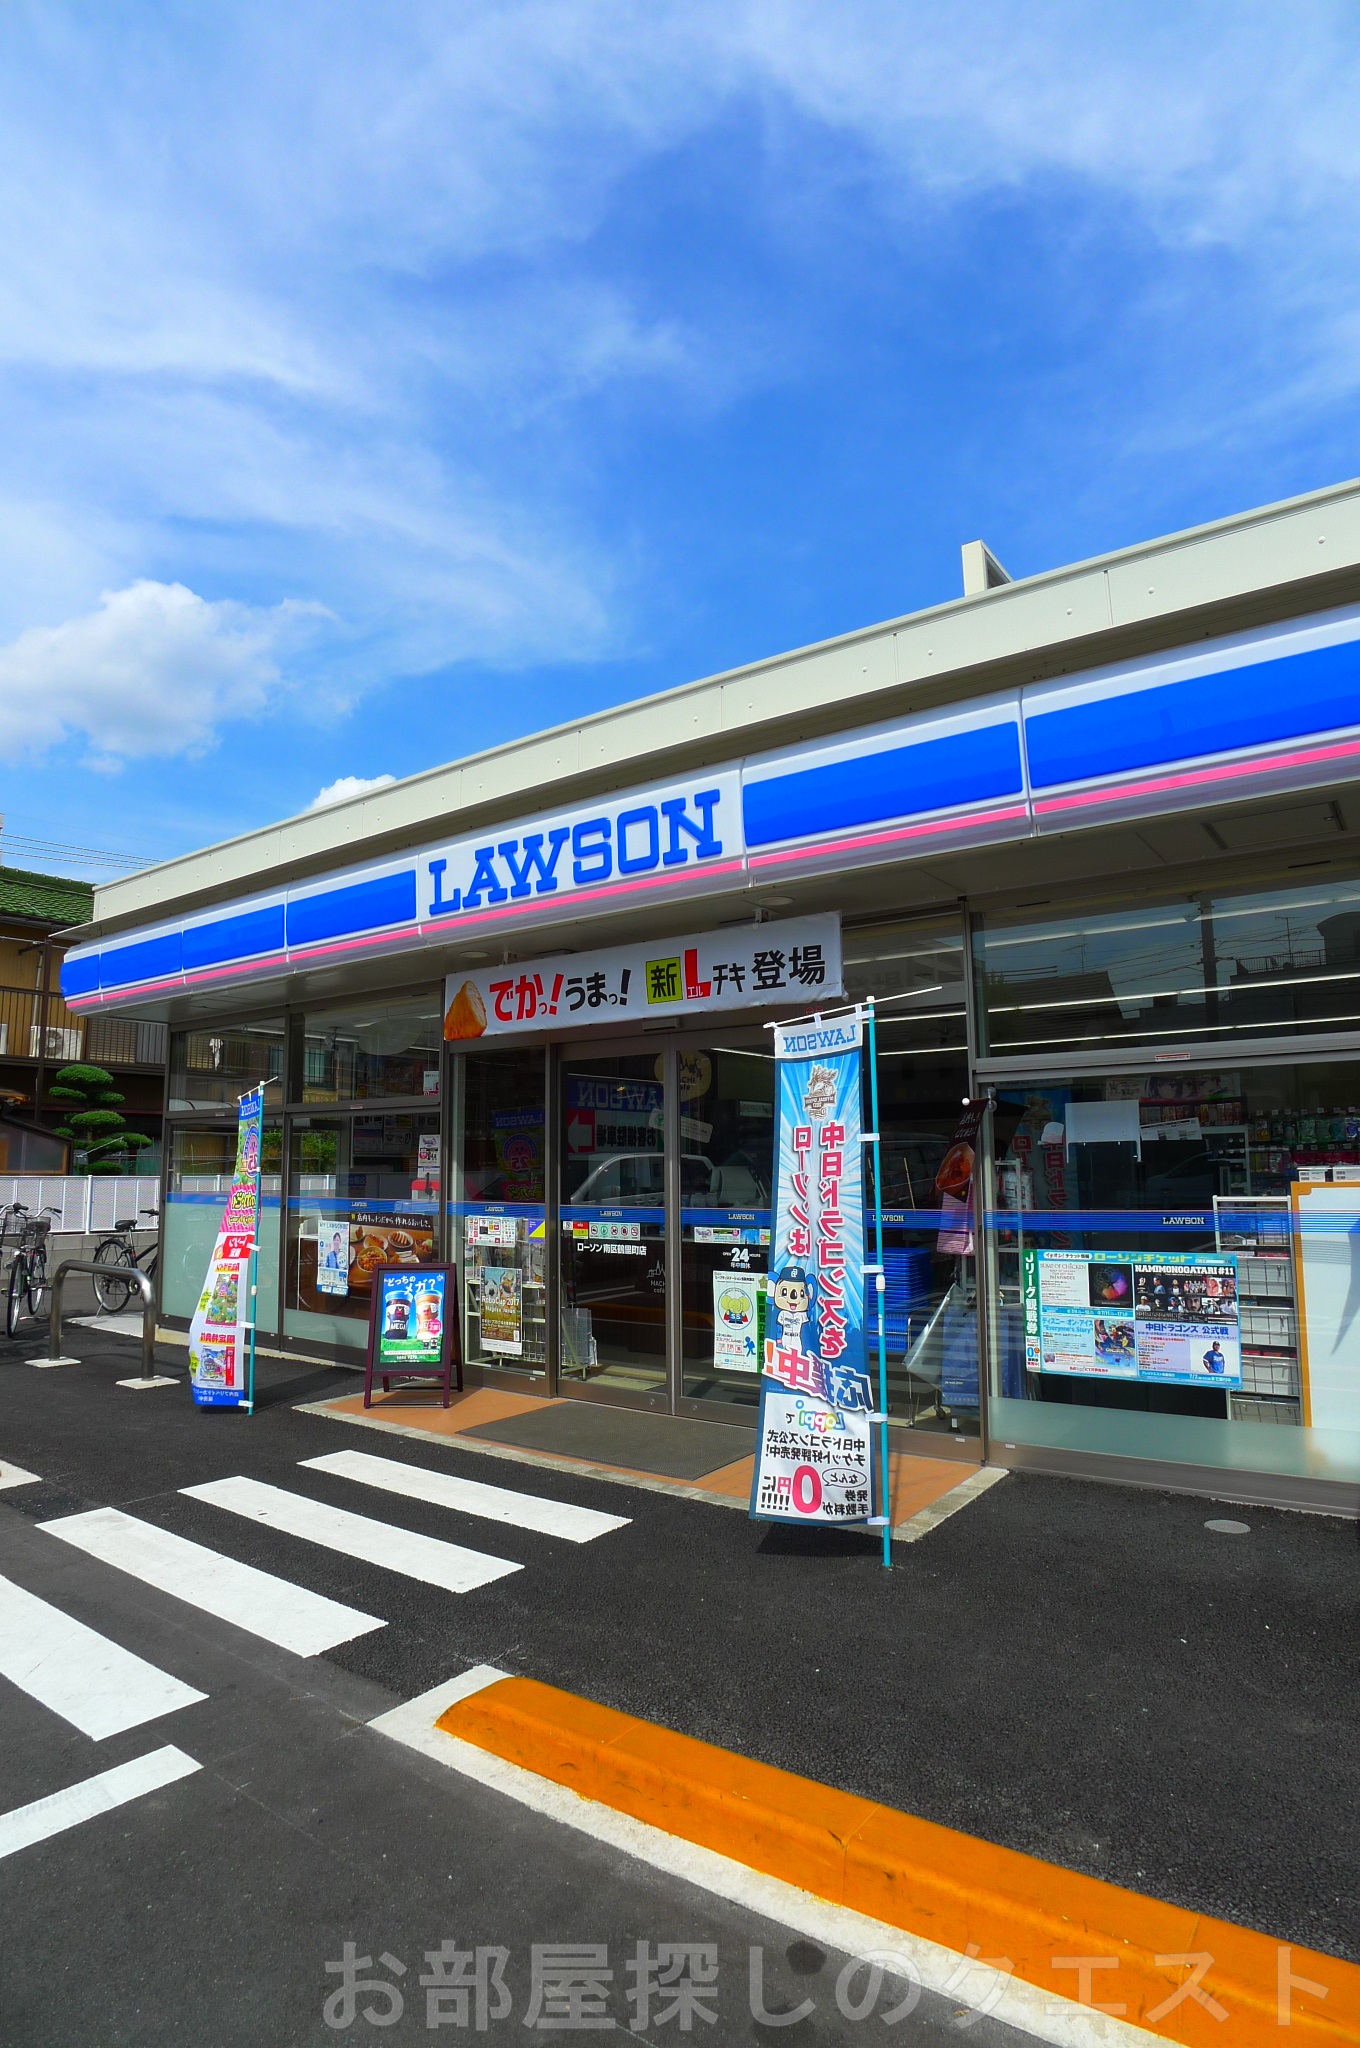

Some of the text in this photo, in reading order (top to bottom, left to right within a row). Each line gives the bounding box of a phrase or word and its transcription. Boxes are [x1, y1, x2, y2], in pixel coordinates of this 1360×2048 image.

[428, 788, 723, 916] LAWSON
[871, 1214, 904, 1222] LWSON
[1162, 1217, 1205, 1225] LAWSON
[577, 1242, 647, 1256] ローソン南区鶴里町店
[731, 1247, 750, 1262] 24
[1094, 1252, 1192, 1263] ローソンチケット
[1135, 1265, 1217, 1274] NAMIMONOGATARI
[387, 1276, 416, 1287] どっちの
[404, 1278, 436, 1296] メガ?
[1025, 1252, 1038, 1334] Jリーグ観戦券
[482, 1296, 520, 1306] RoboCup 2017
[1145, 1323, 1229, 1335] 中日ドラゴンズ 公式戦
